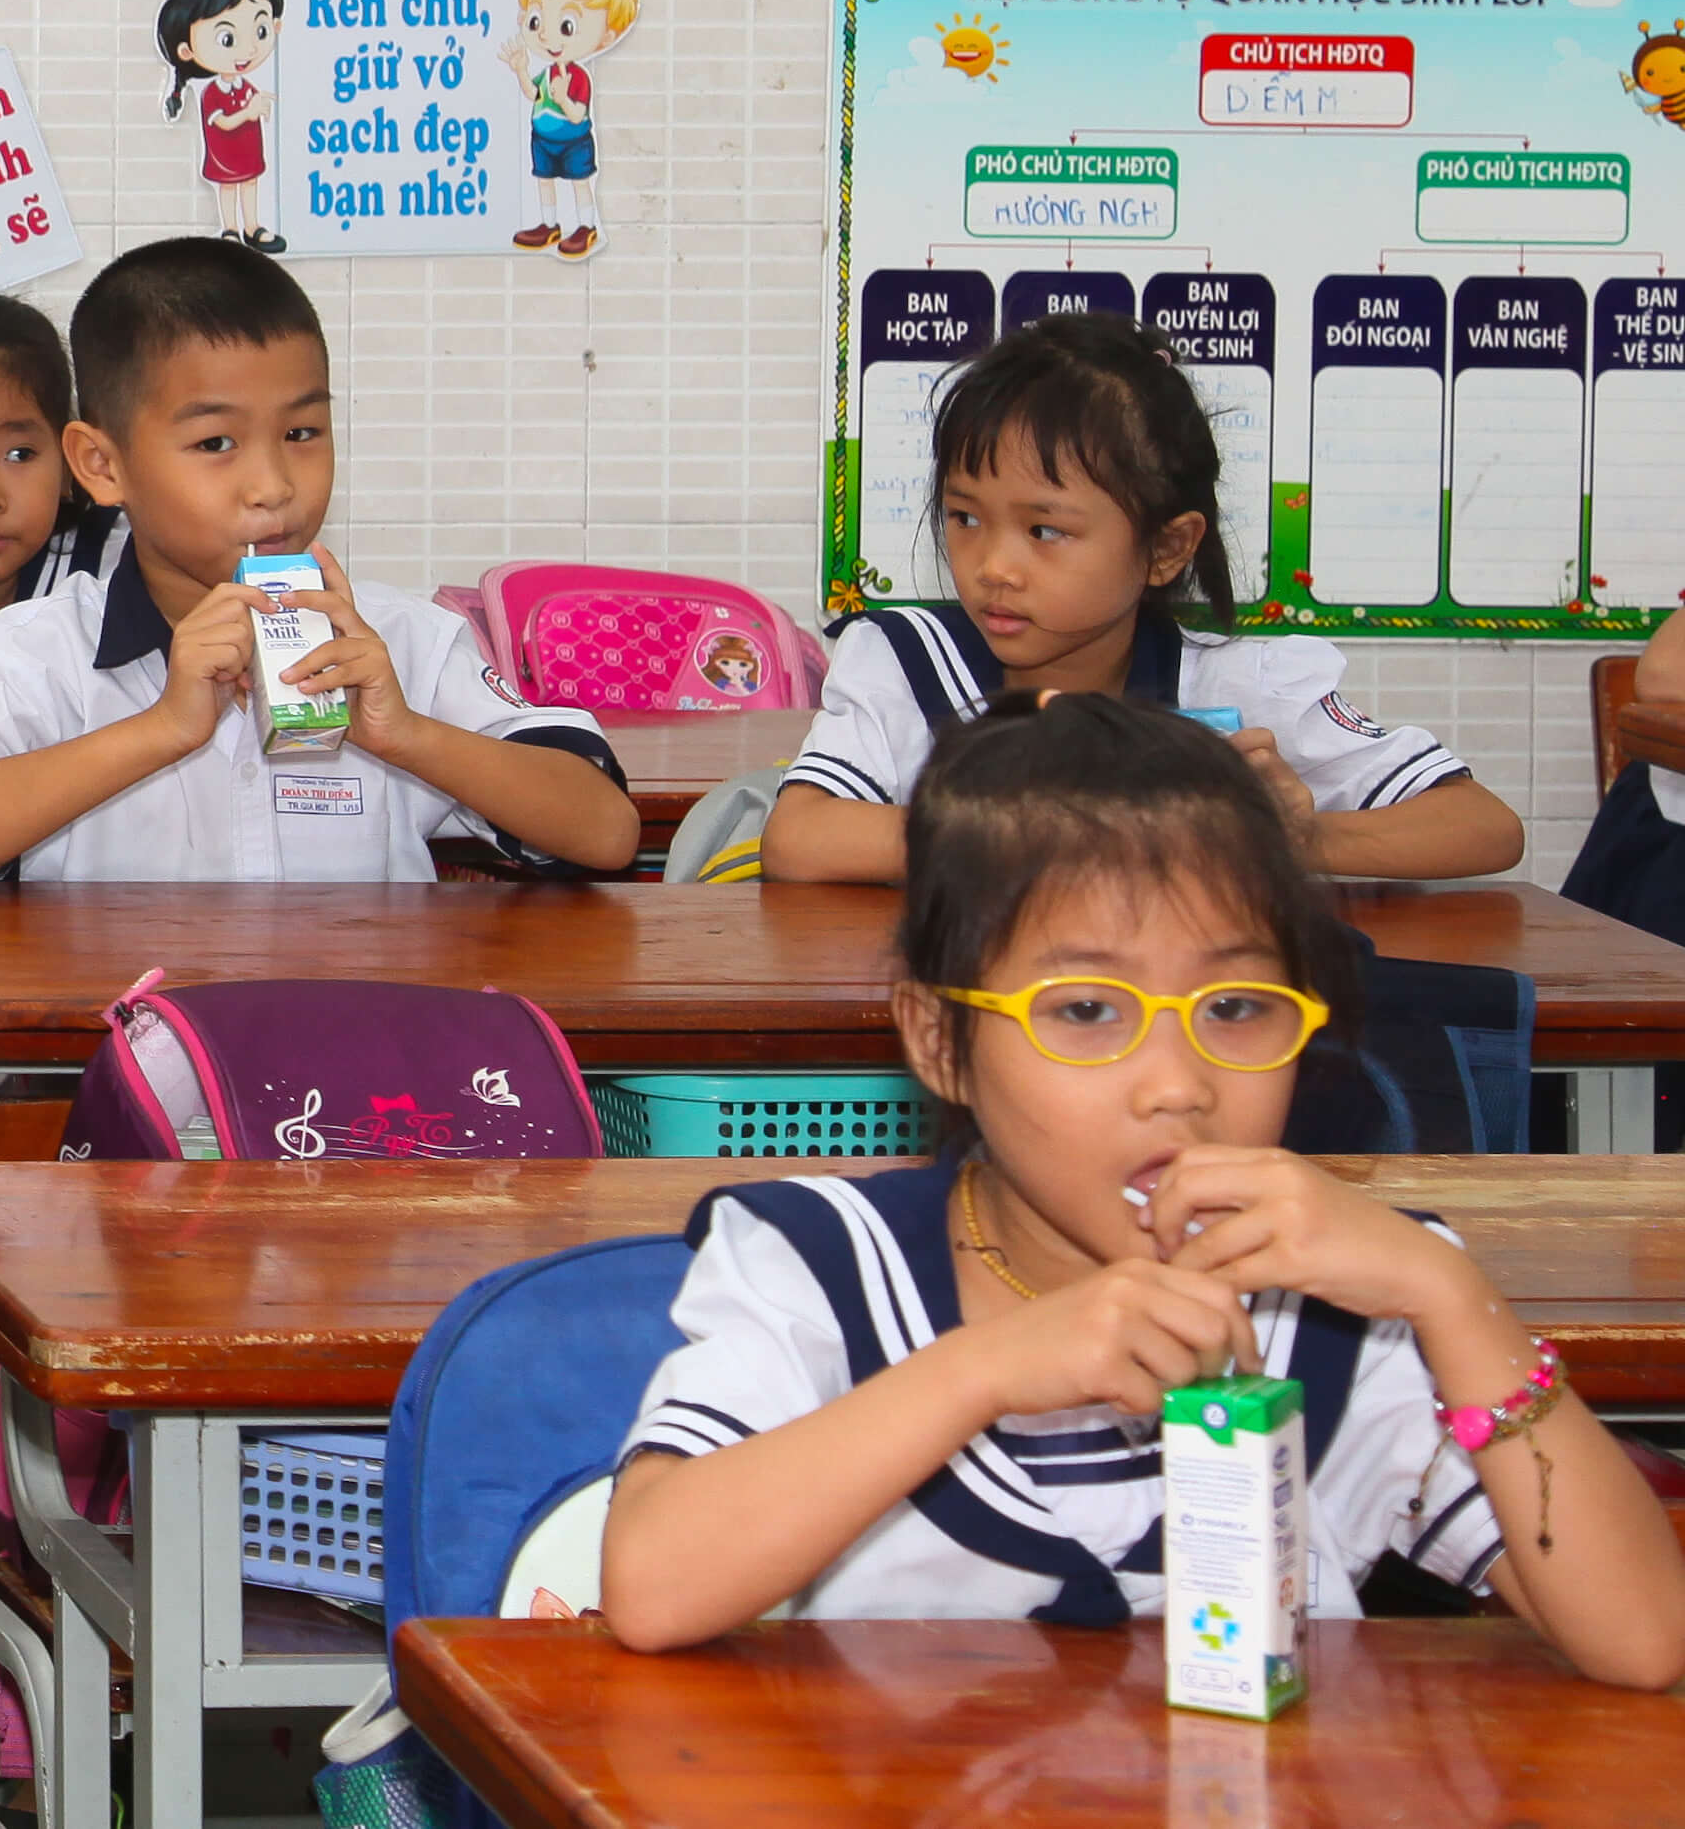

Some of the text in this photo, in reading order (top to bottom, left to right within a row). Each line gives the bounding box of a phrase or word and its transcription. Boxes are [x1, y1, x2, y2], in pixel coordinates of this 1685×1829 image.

[1229, 36, 1386, 70] CHỦ TỊCH HĐTQ
[332, 34, 466, 104] giữ vở
[307, 101, 490, 169] sạch đẹp
[974, 149, 1172, 182] PHÓ CHỦ TỊCH HĐTQ
[1425, 153, 1624, 187] PHÓ CHỦ TỊCH HĐTQ
[307, 165, 488, 232] bạn nhé!
[907, 292, 949, 315] BAN
[1047, 294, 1089, 315] BAN
[1187, 280, 1230, 303] BAN
[1635, 286, 1678, 309] BAN
[1155, 303, 1260, 334] QUYỀN LỢI
[1358, 297, 1401, 320] BAN
[1497, 299, 1540, 321] BAN
[886, 318, 969, 348] HỌC TẬP
[1326, 319, 1431, 354] ĐỐI NGOẠI
[1467, 323, 1569, 355] VĂN NGHỆ
[1613, 309, 1685, 342] THỂ DỤ
[1206, 337, 1255, 359] SINH
[1622, 340, 1685, 369] VỆ SIN
[261, 614, 301, 627] Fresh
[264, 626, 304, 640] Milk
